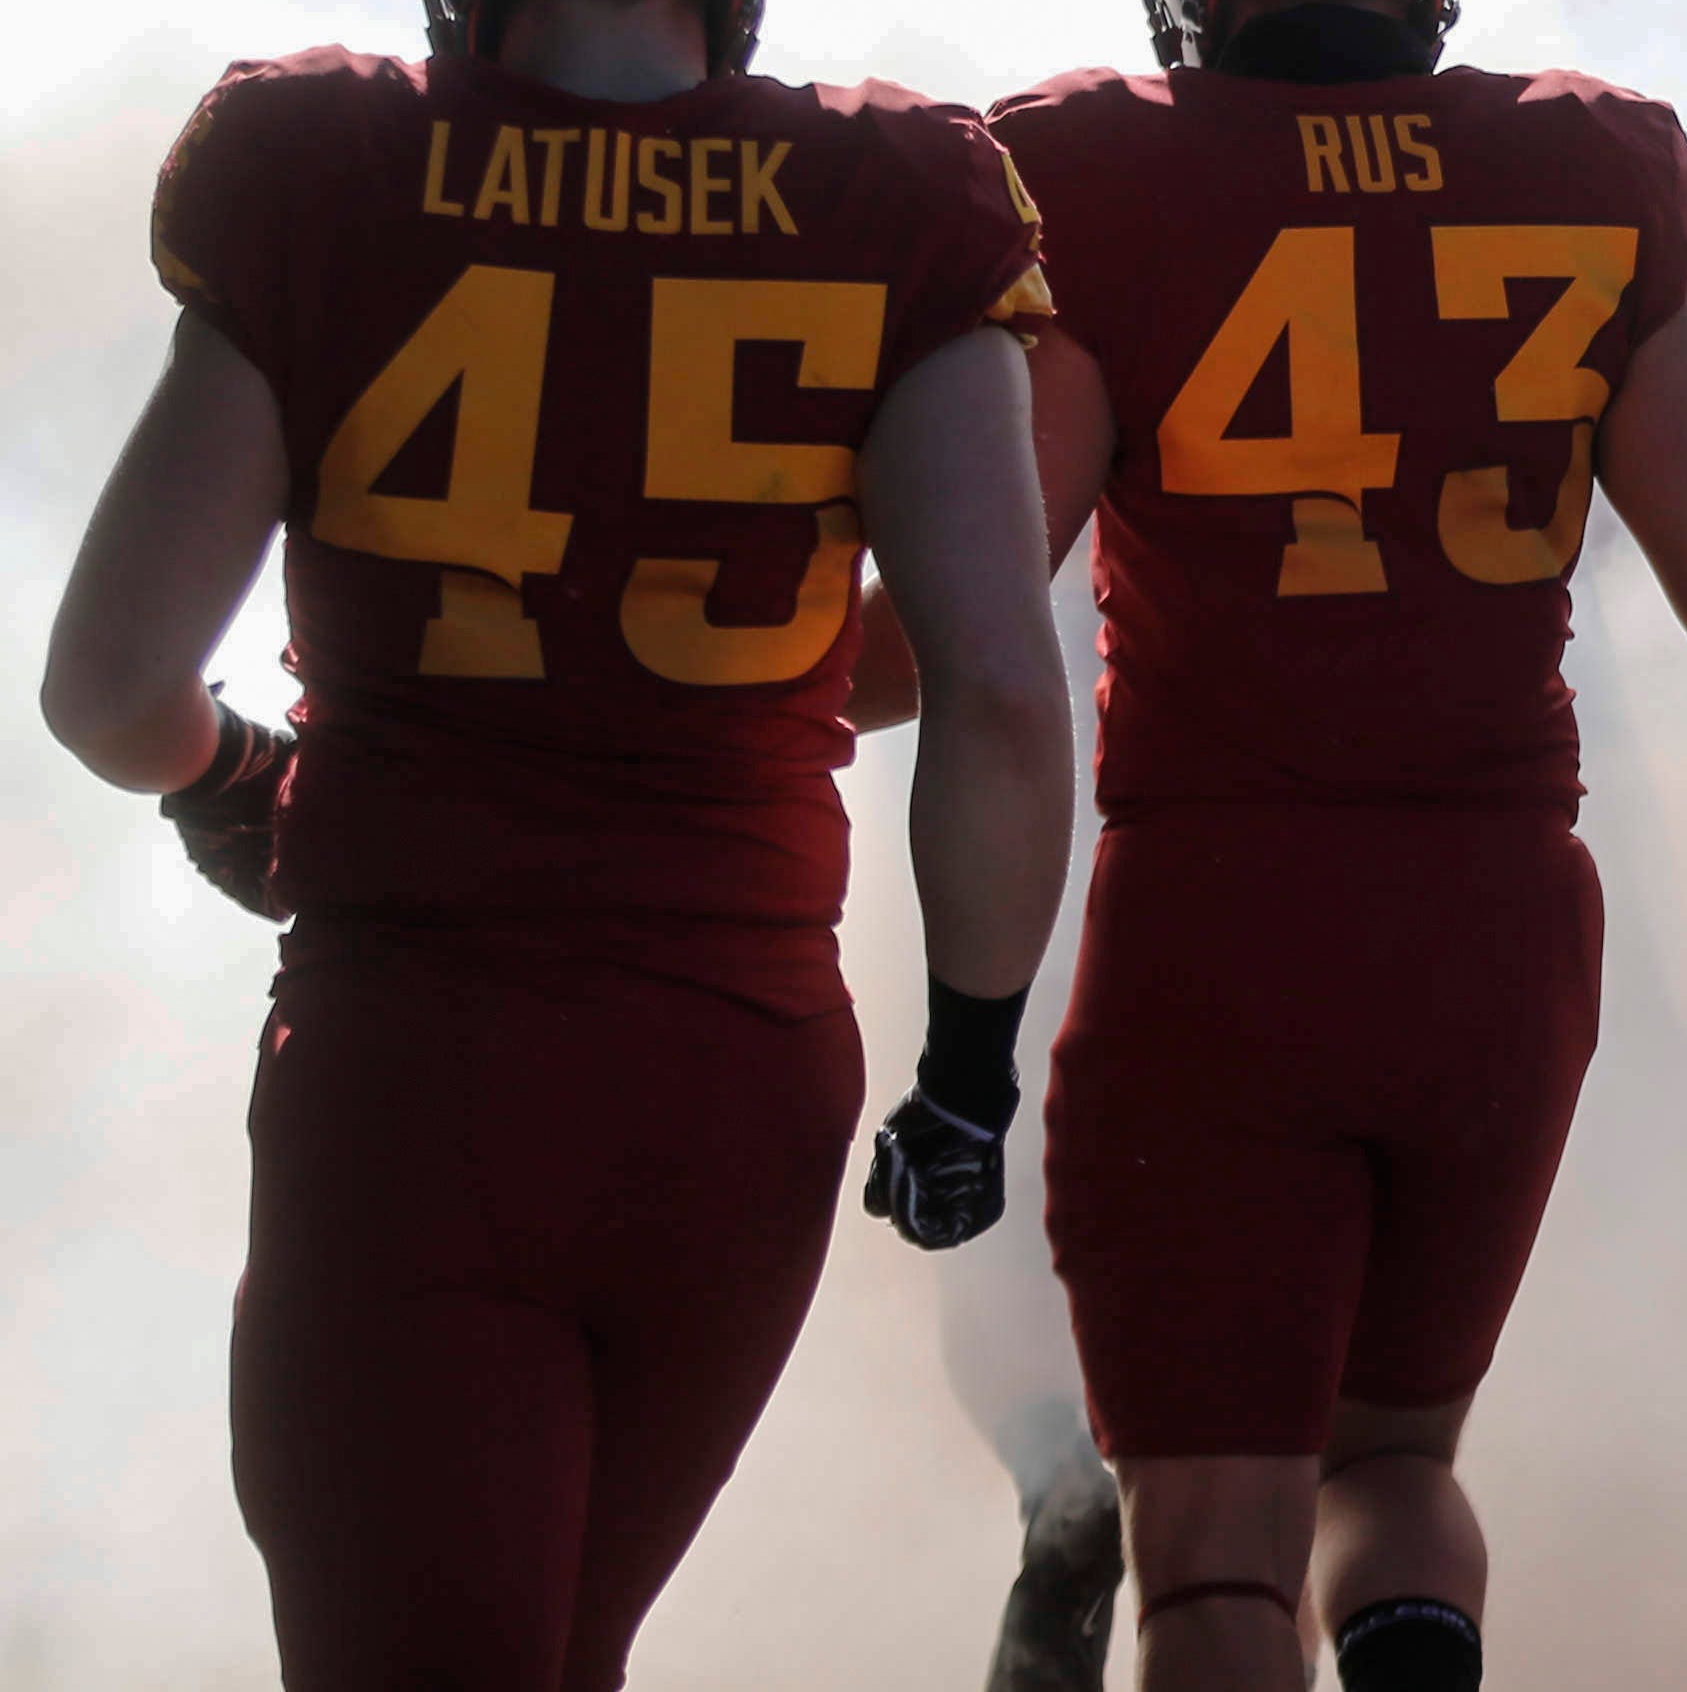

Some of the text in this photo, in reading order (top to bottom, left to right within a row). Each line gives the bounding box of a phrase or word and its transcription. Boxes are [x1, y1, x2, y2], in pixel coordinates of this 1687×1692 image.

[422, 120, 800, 235] LATUSEK
[1297, 114, 1444, 193] RUS
[312, 264, 888, 686] 45
[1157, 225, 1640, 598] 43
